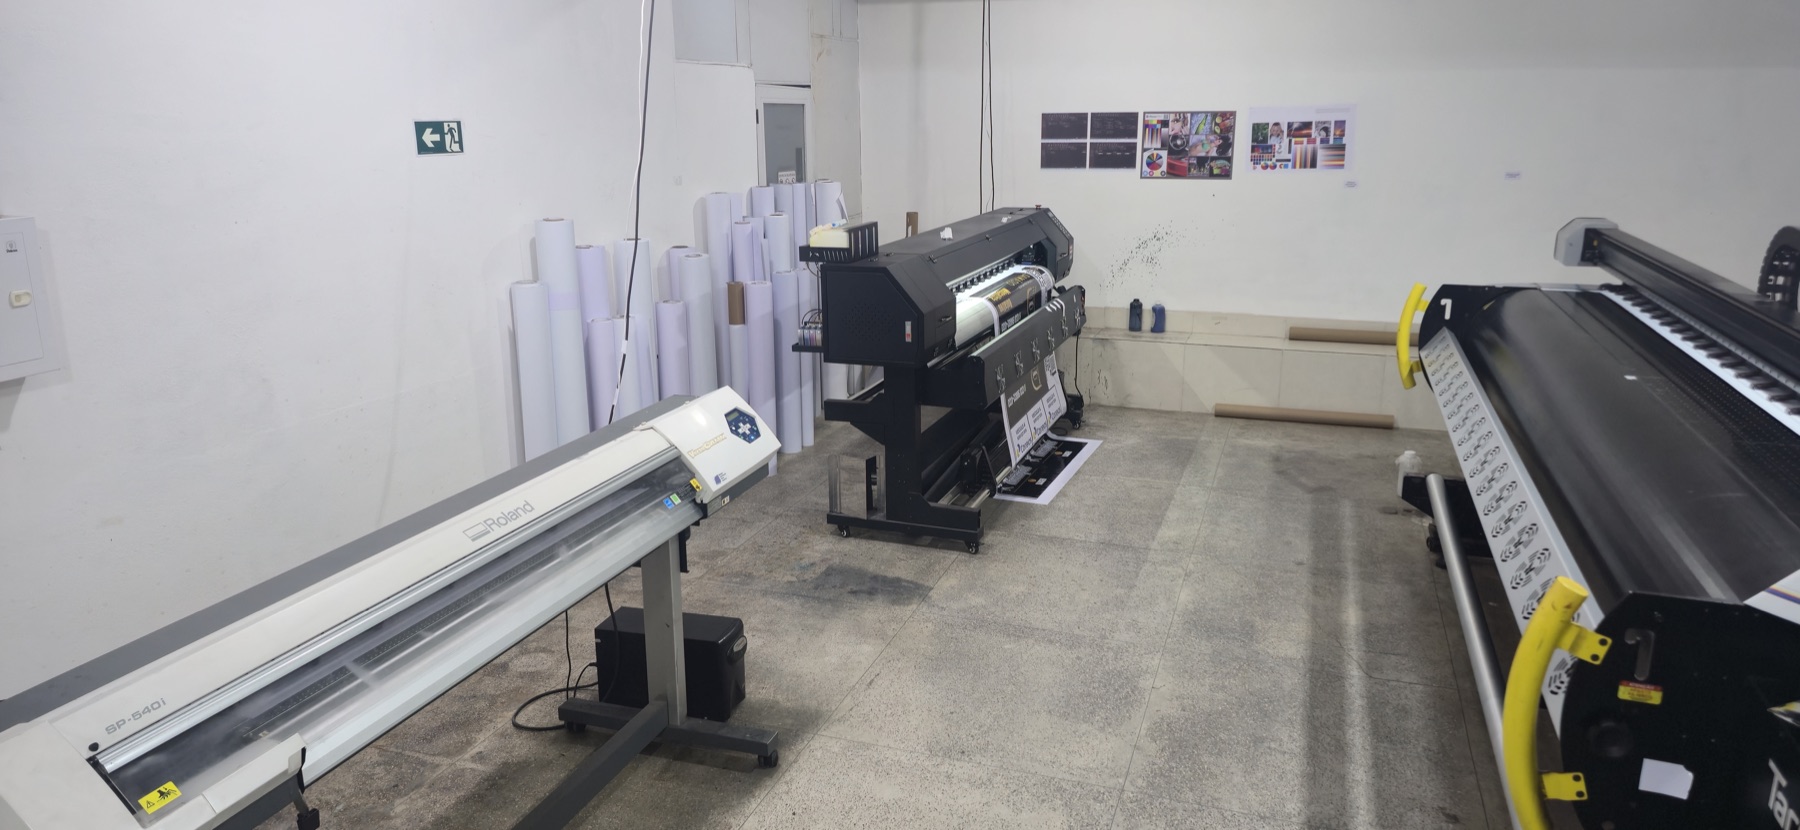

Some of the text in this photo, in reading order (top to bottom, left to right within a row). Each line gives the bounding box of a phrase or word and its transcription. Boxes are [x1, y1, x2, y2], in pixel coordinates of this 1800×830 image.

[483, 500, 535, 532] Roland
[105, 698, 166, 735] SP-540i
[1768, 758, 1800, 830] Tar
